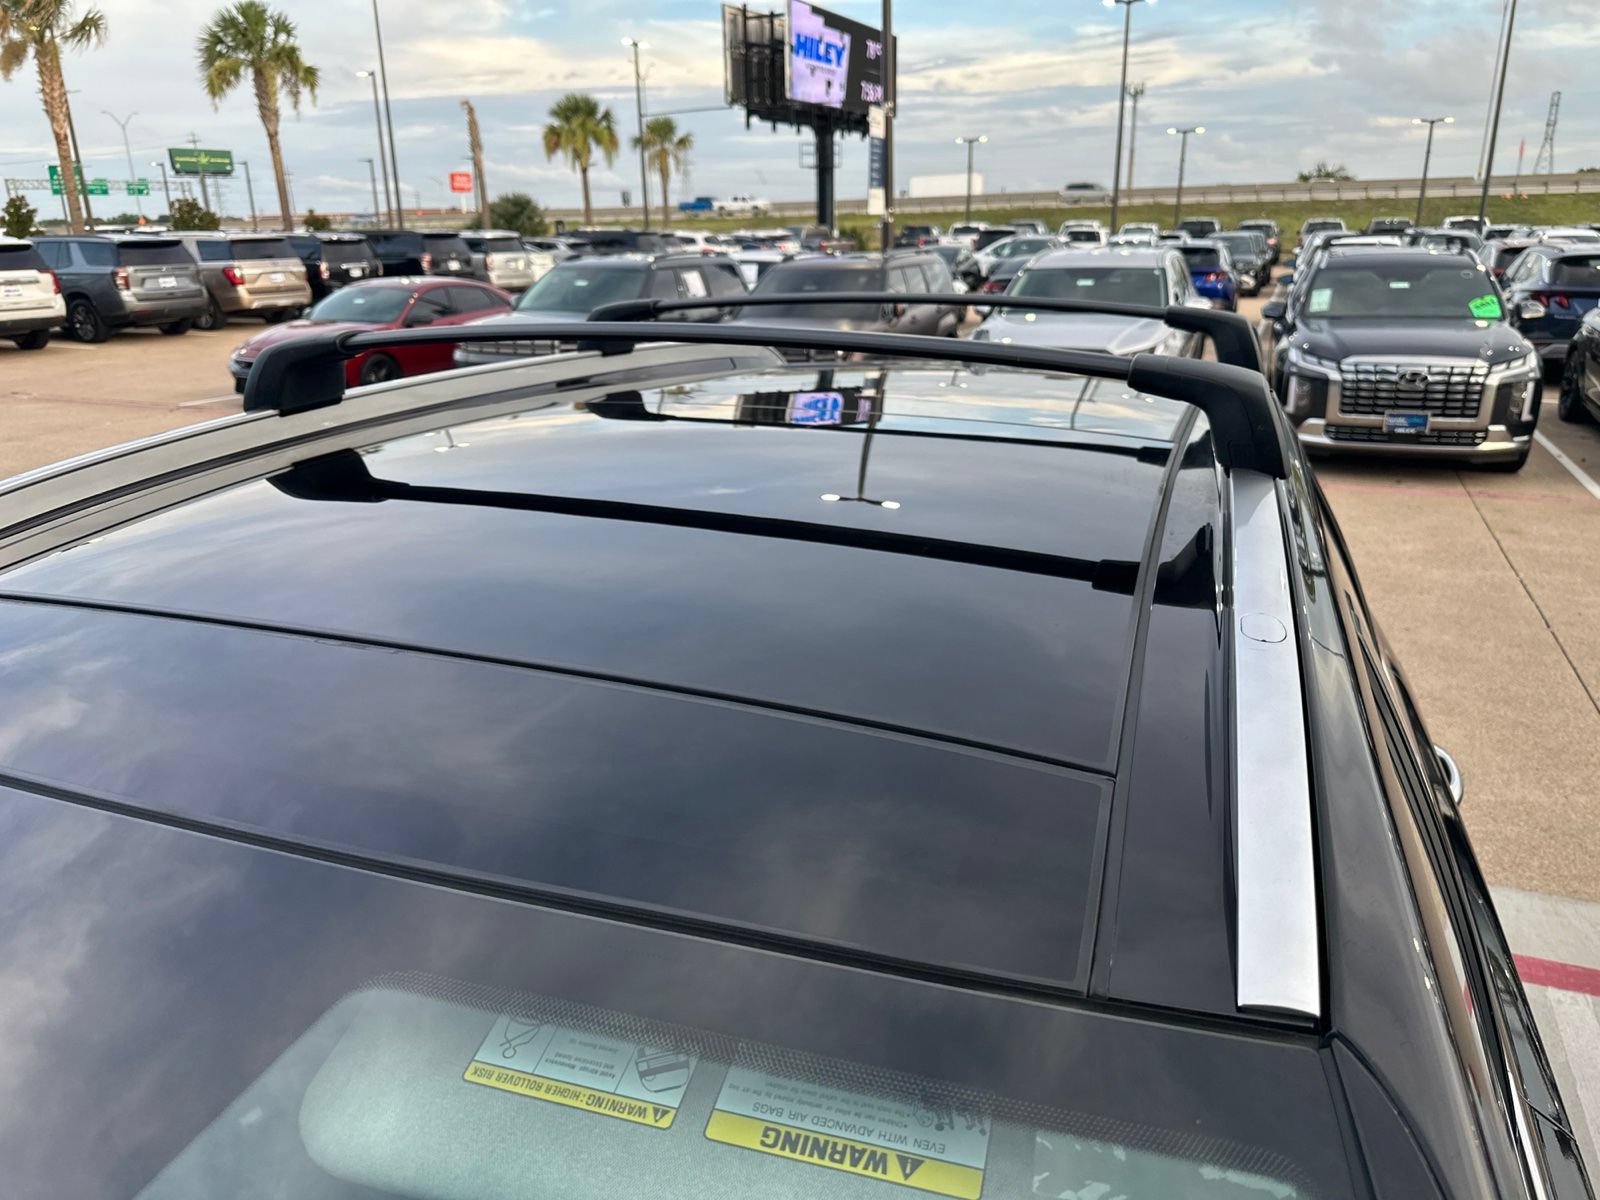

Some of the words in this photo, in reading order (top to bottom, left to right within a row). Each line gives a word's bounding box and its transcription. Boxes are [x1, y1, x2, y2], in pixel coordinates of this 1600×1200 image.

[794, 33, 844, 68] HILEY
[470, 1065, 495, 1080] RISK
[494, 1071, 544, 1092] ROLLOVER
[543, 1083, 581, 1101] HIGHER
[580, 1092, 647, 1119] WARNING:
[750, 1100, 784, 1117] BAGS
[787, 1109, 808, 1123] AIR
[810, 1114, 874, 1138] ADVANCED
[877, 1129, 908, 1146] WITH
[911, 1137, 946, 1154] EVEN
[759, 1125, 889, 1176] WARNING
